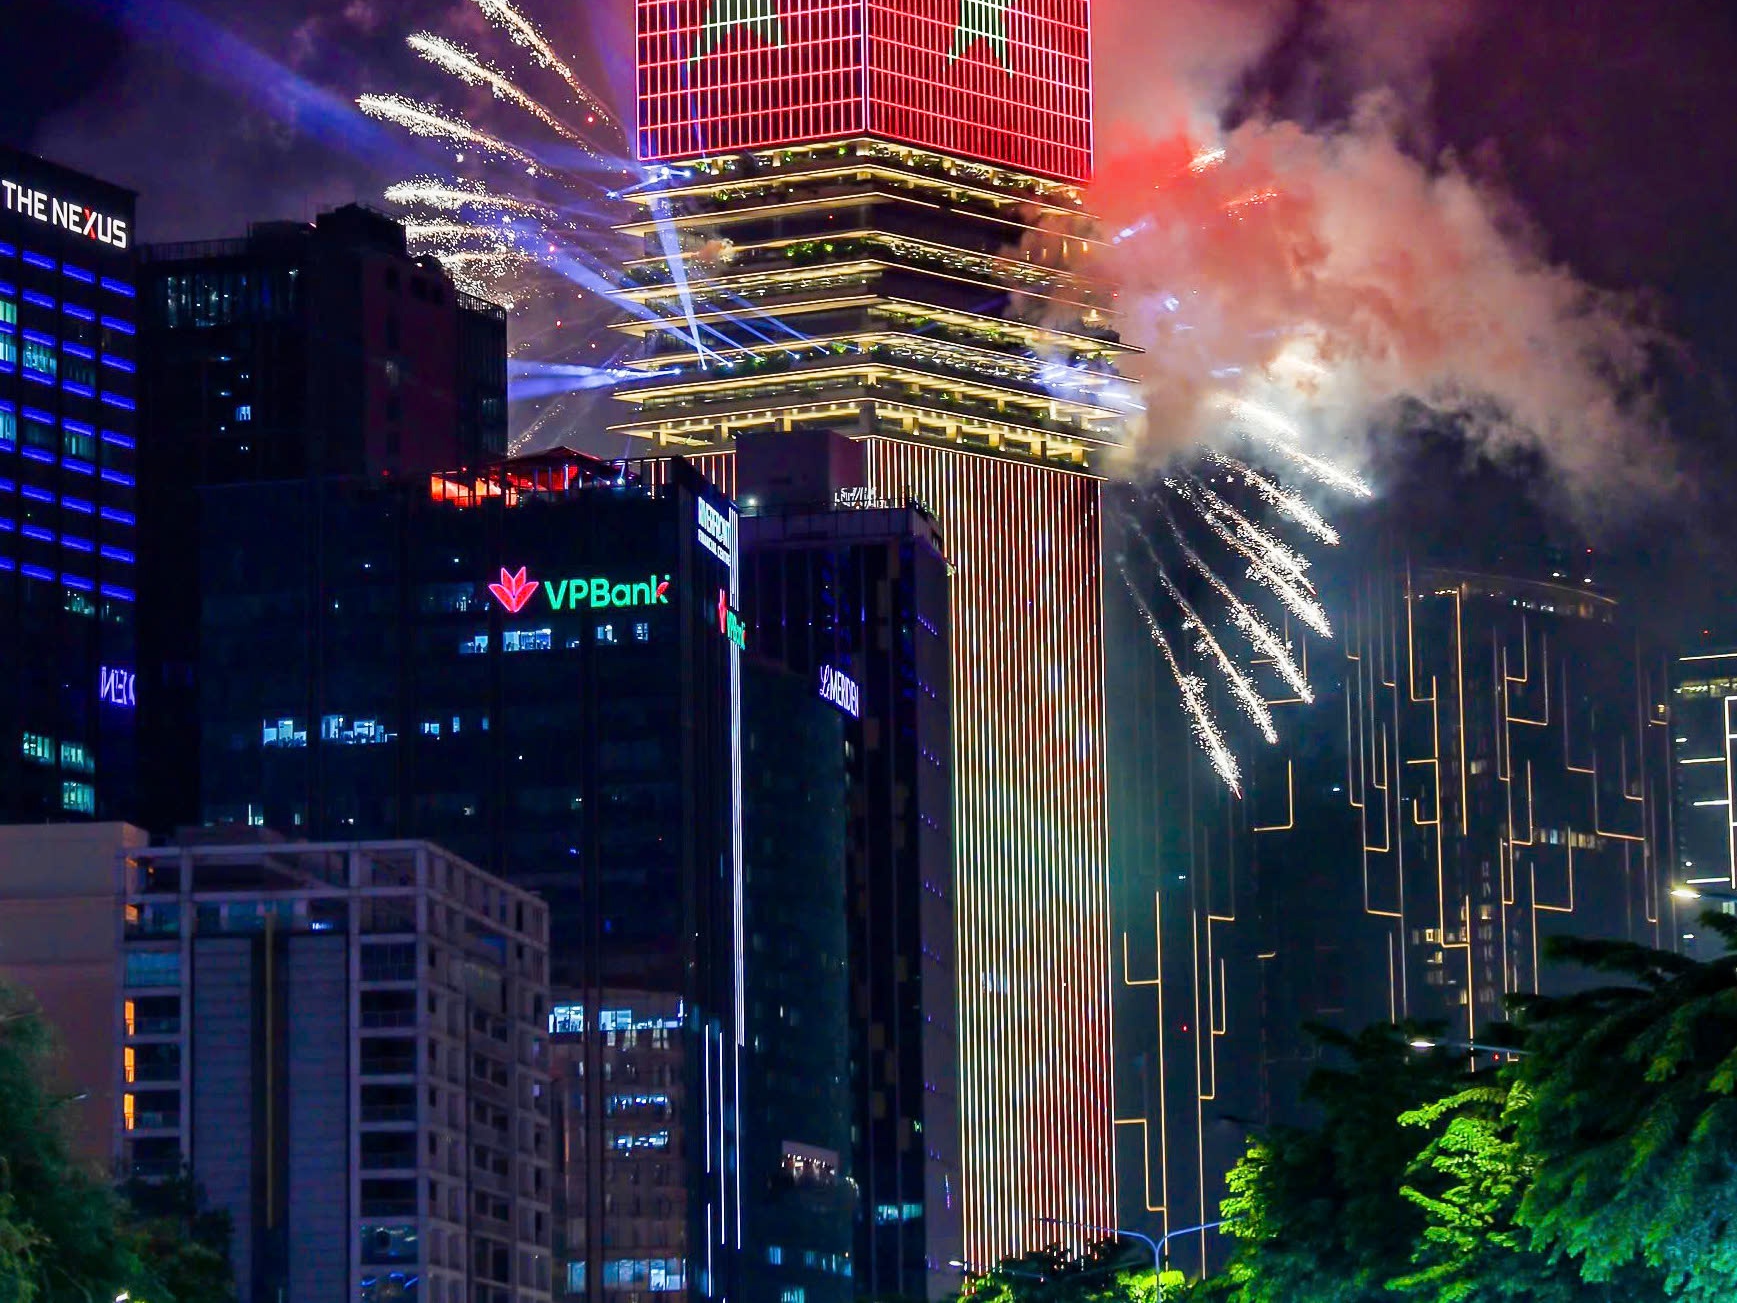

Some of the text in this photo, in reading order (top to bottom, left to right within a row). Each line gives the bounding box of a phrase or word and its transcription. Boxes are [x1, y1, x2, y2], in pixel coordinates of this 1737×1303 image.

[1, 179, 127, 249] THE NEXUS
[544, 574, 671, 610] VPBank
